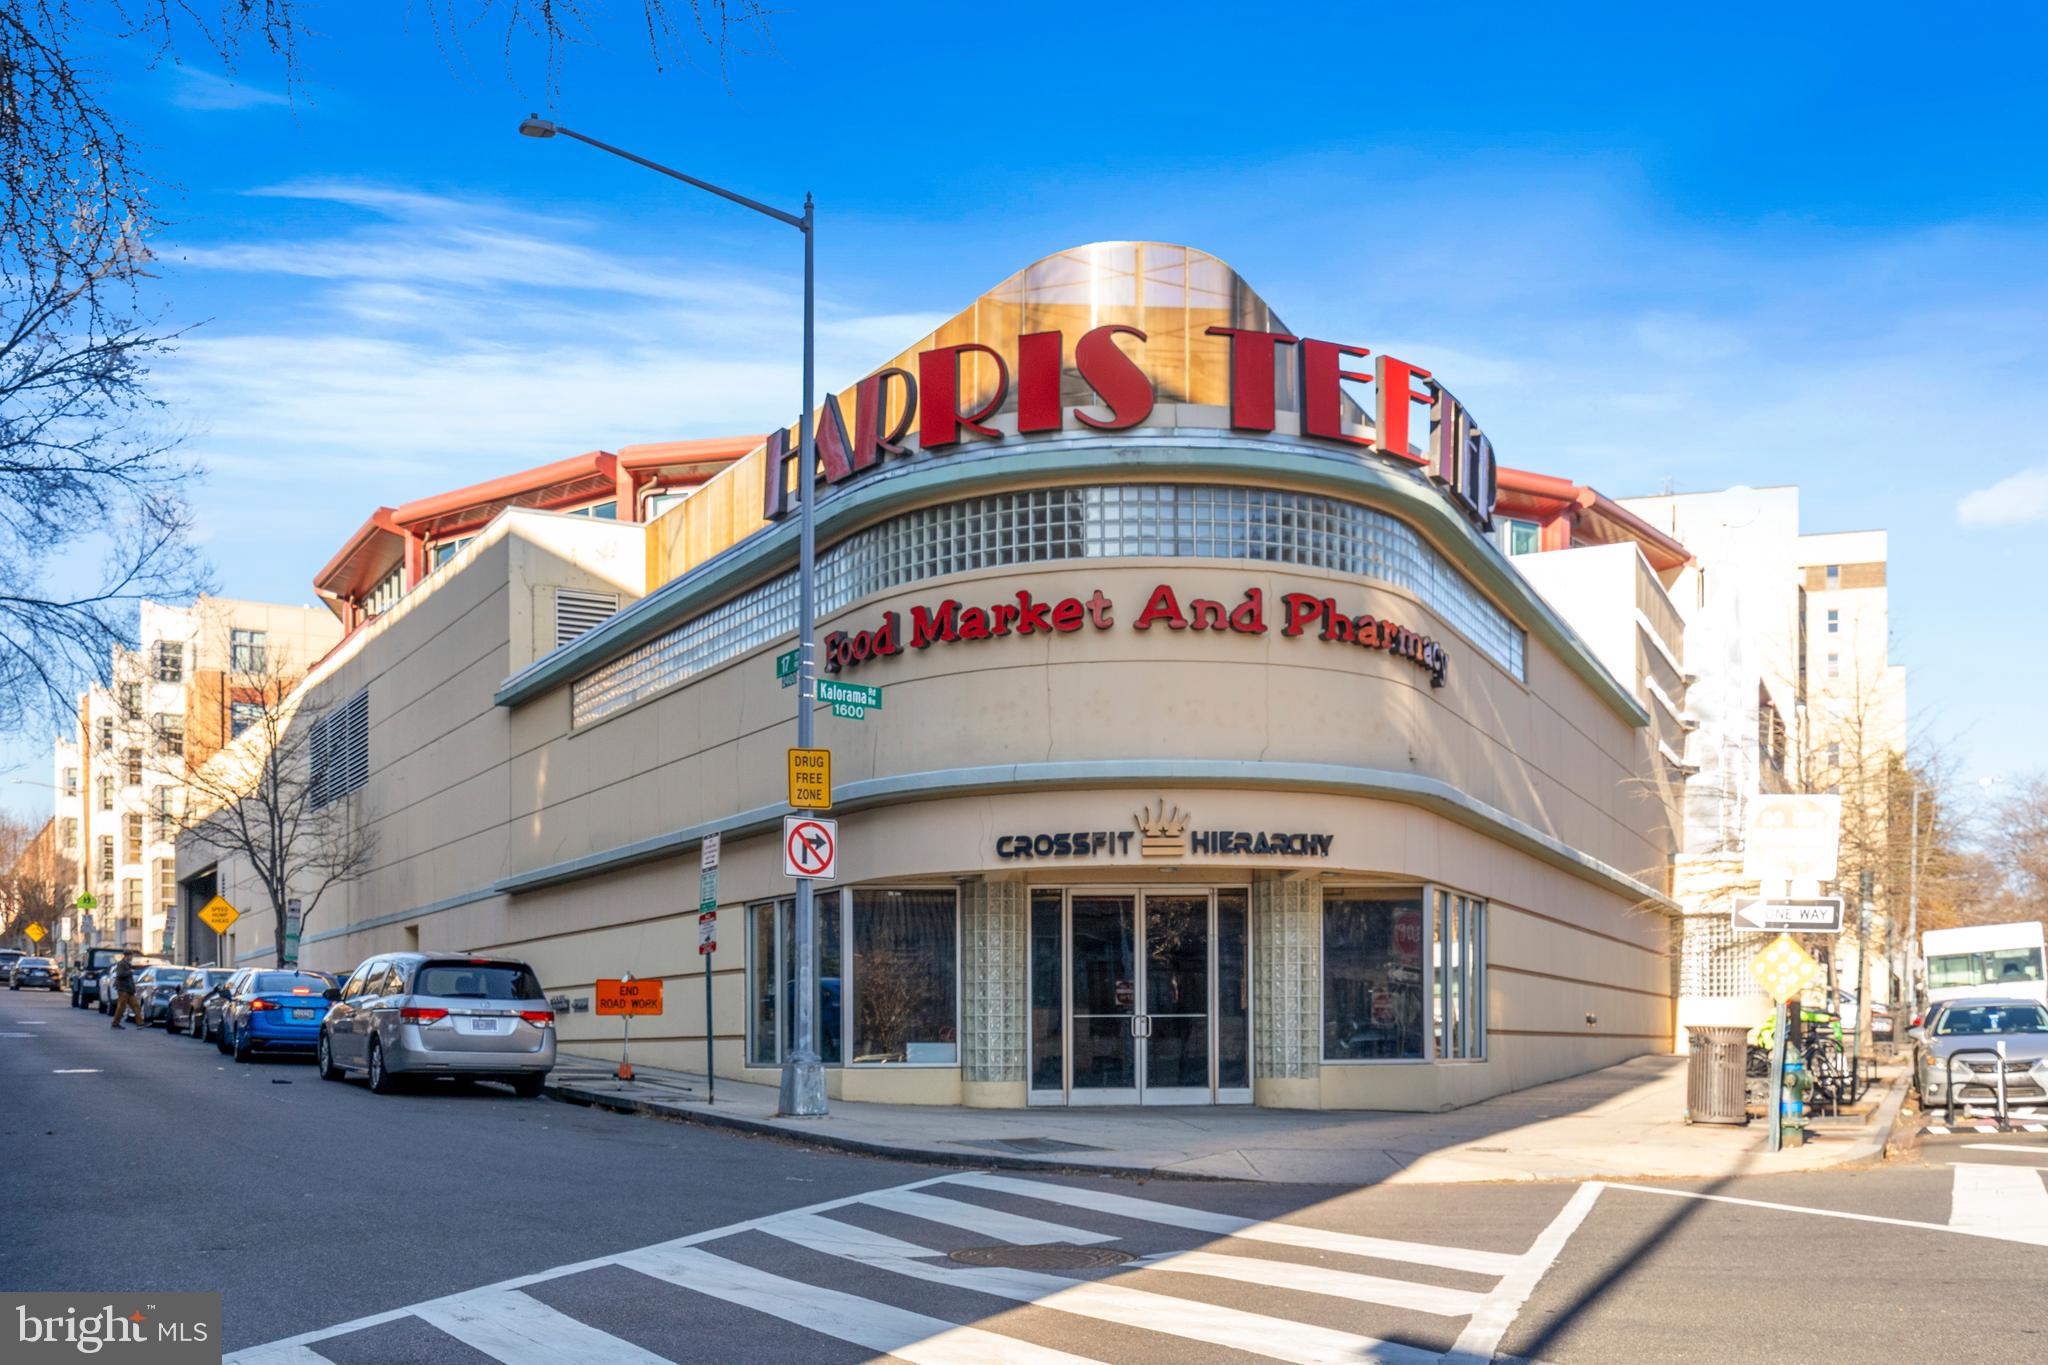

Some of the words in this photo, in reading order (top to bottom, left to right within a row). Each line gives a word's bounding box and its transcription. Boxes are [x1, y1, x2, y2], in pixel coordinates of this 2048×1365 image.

[763, 324, 1155, 521] HARRIS
[823, 612, 904, 674] Food
[910, 589, 1114, 651] Market
[1132, 584, 1268, 635] And
[1280, 592, 1451, 689] Pharmacy
[820, 682, 867, 705] Kalorama
[835, 703, 864, 718] 1600
[794, 755, 824, 768] DRUG
[795, 772, 823, 784] FREE
[796, 788, 822, 800] ZONE
[996, 831, 1135, 860] CROSSFIT
[1191, 830, 1334, 857] HIERARCHY
[1765, 908, 1792, 920] ONE
[1800, 909, 1828, 920] WAY
[619, 986, 639, 996] END
[600, 998, 626, 1009] ROAD
[631, 998, 658, 1009] WORK
